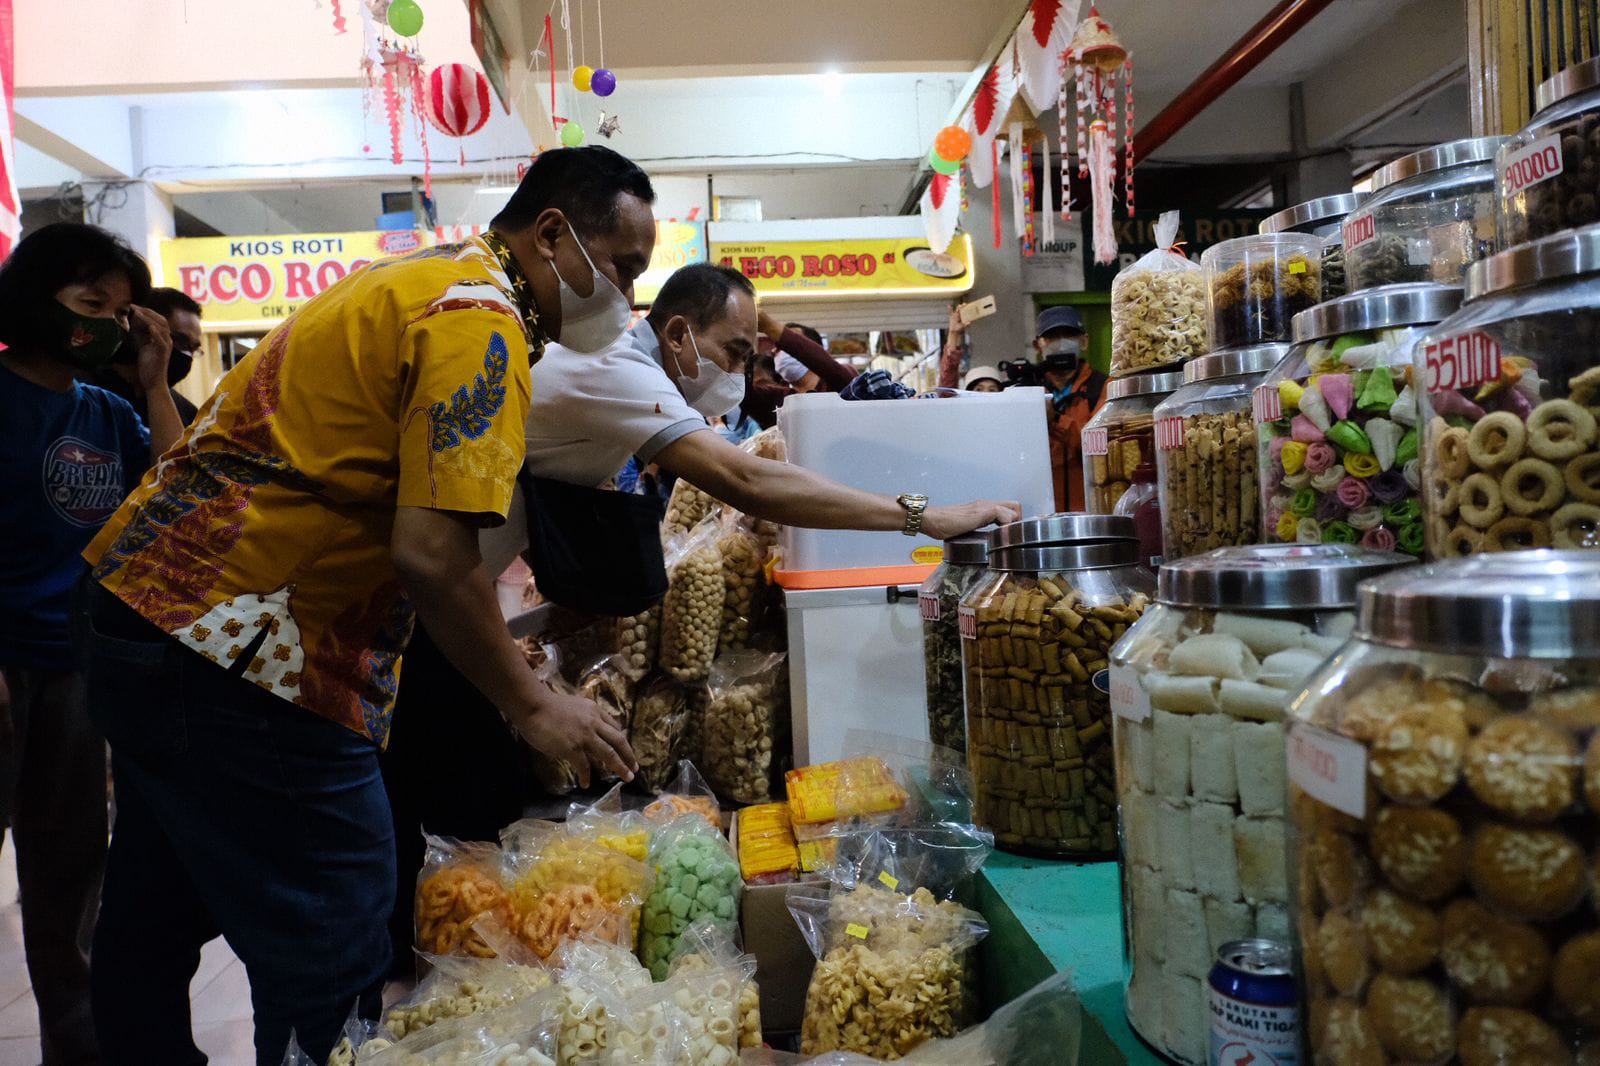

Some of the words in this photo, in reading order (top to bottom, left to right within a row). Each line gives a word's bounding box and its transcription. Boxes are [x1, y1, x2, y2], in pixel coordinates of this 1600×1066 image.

[1504, 144, 1560, 194] 90000
[230, 241, 284, 256] KIOS
[292, 239, 343, 254] ROTI
[739, 255, 796, 279] ECO
[801, 252, 877, 277] ROSO
[178, 262, 272, 302] ECO
[284, 259, 371, 299] RO
[262, 305, 284, 318] CIK
[1424, 330, 1502, 393] 55000
[48, 459, 124, 487] BREAK
[1226, 1013, 1259, 1030] KAKI
